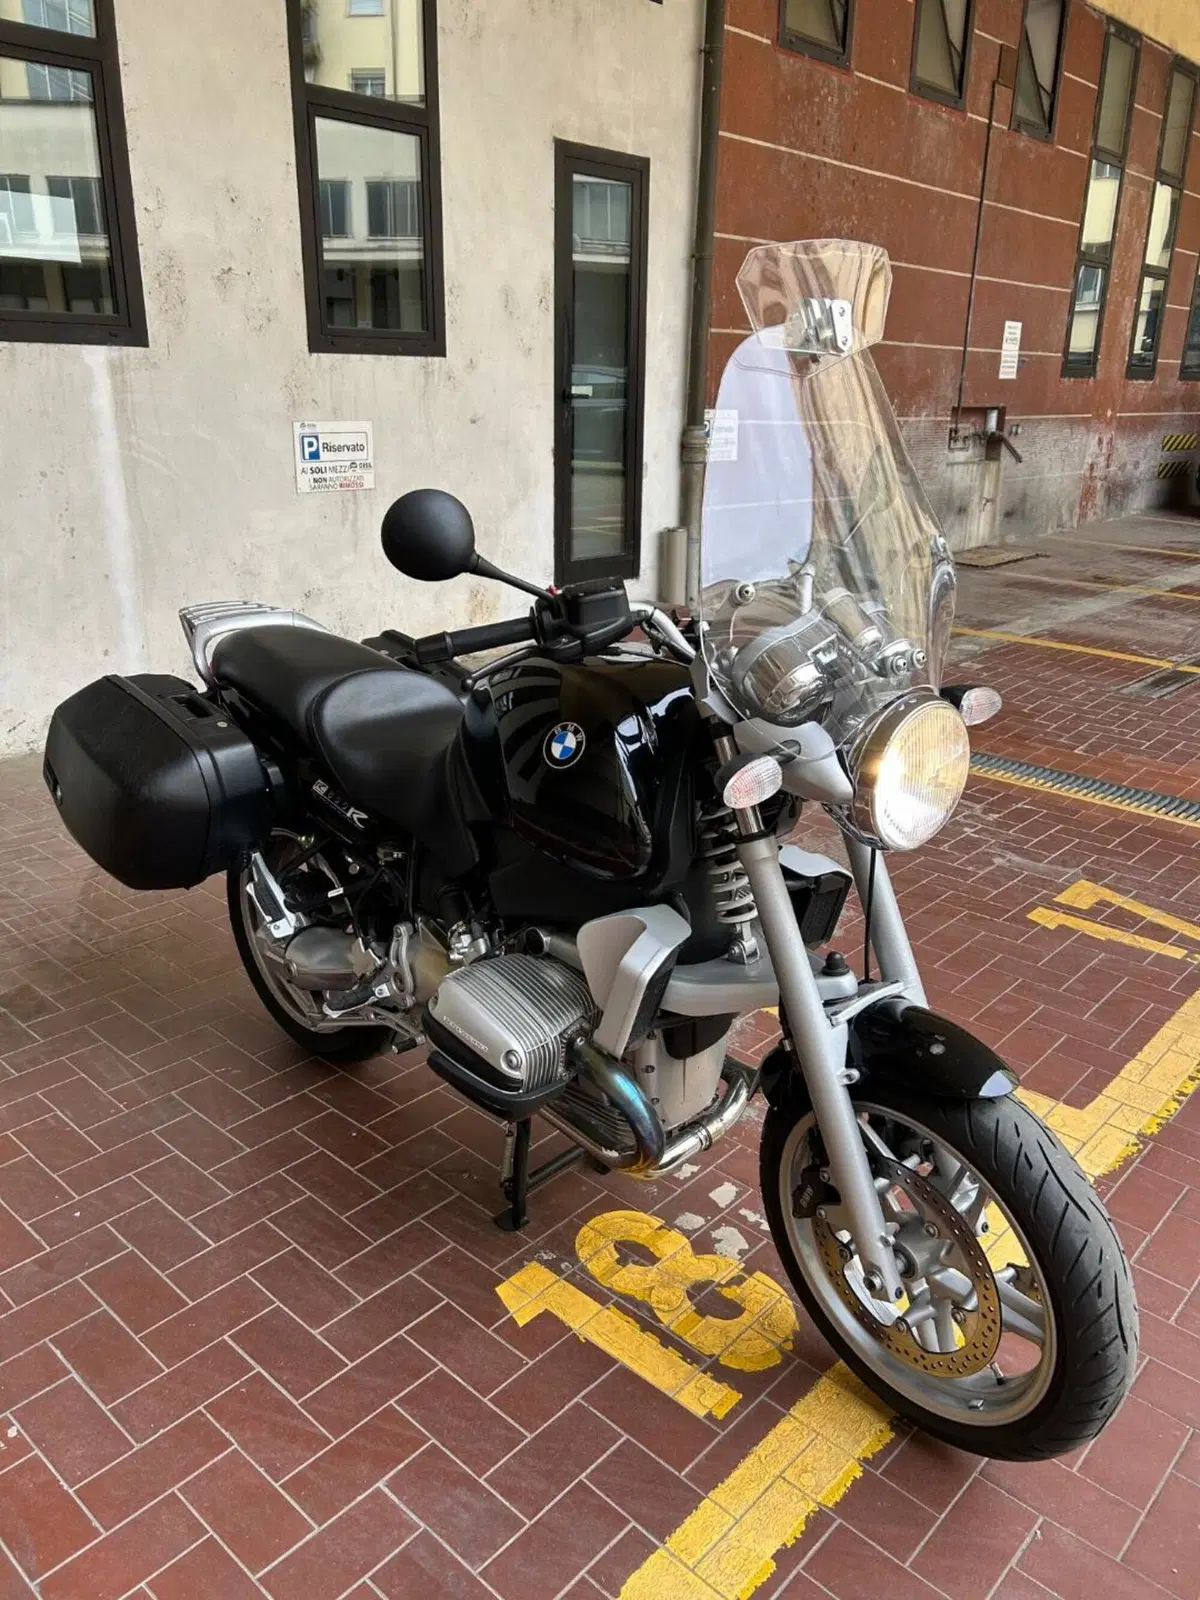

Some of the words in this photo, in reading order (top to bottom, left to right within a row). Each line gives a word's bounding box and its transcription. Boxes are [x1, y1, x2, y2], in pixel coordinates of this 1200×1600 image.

[302, 436, 319, 460] P
[321, 441, 366, 453] Riservato
[309, 466, 328, 475] SOLI
[328, 464, 350, 474] MEZZI
[309, 483, 338, 491] SARANNO
[495, 1209, 800, 1421] 18
